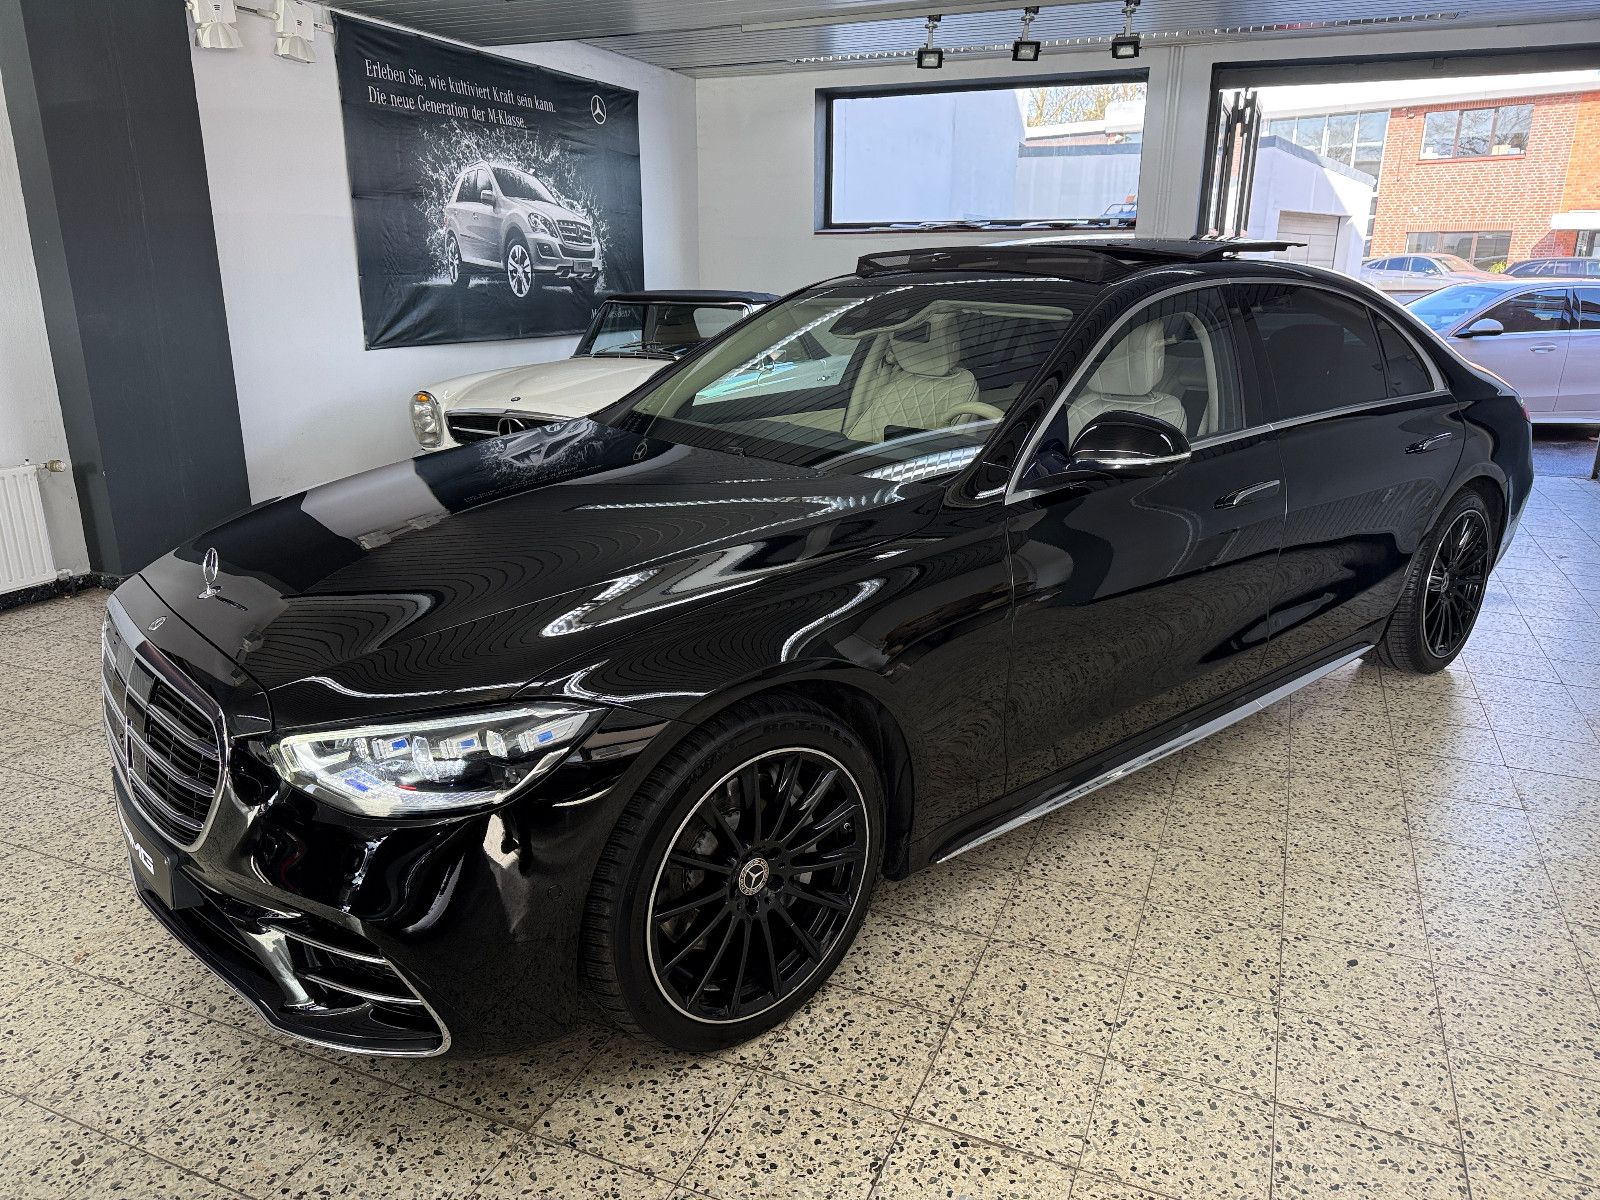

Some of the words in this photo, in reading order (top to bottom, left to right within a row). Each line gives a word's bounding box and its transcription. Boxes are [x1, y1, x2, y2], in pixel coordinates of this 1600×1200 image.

[364, 58, 406, 84] Erleben
[408, 68, 427, 91] Sie,
[428, 74, 447, 91] wie
[448, 76, 491, 101] kultiviert
[492, 85, 515, 105] Kraft
[516, 94, 534, 109] sein
[534, 95, 557, 113] kann.
[368, 85, 387, 105] Die
[390, 94, 415, 110] neue
[417, 94, 469, 119] Generation
[471, 105, 486, 122] der
[488, 107, 528, 129] M-Klasse.
